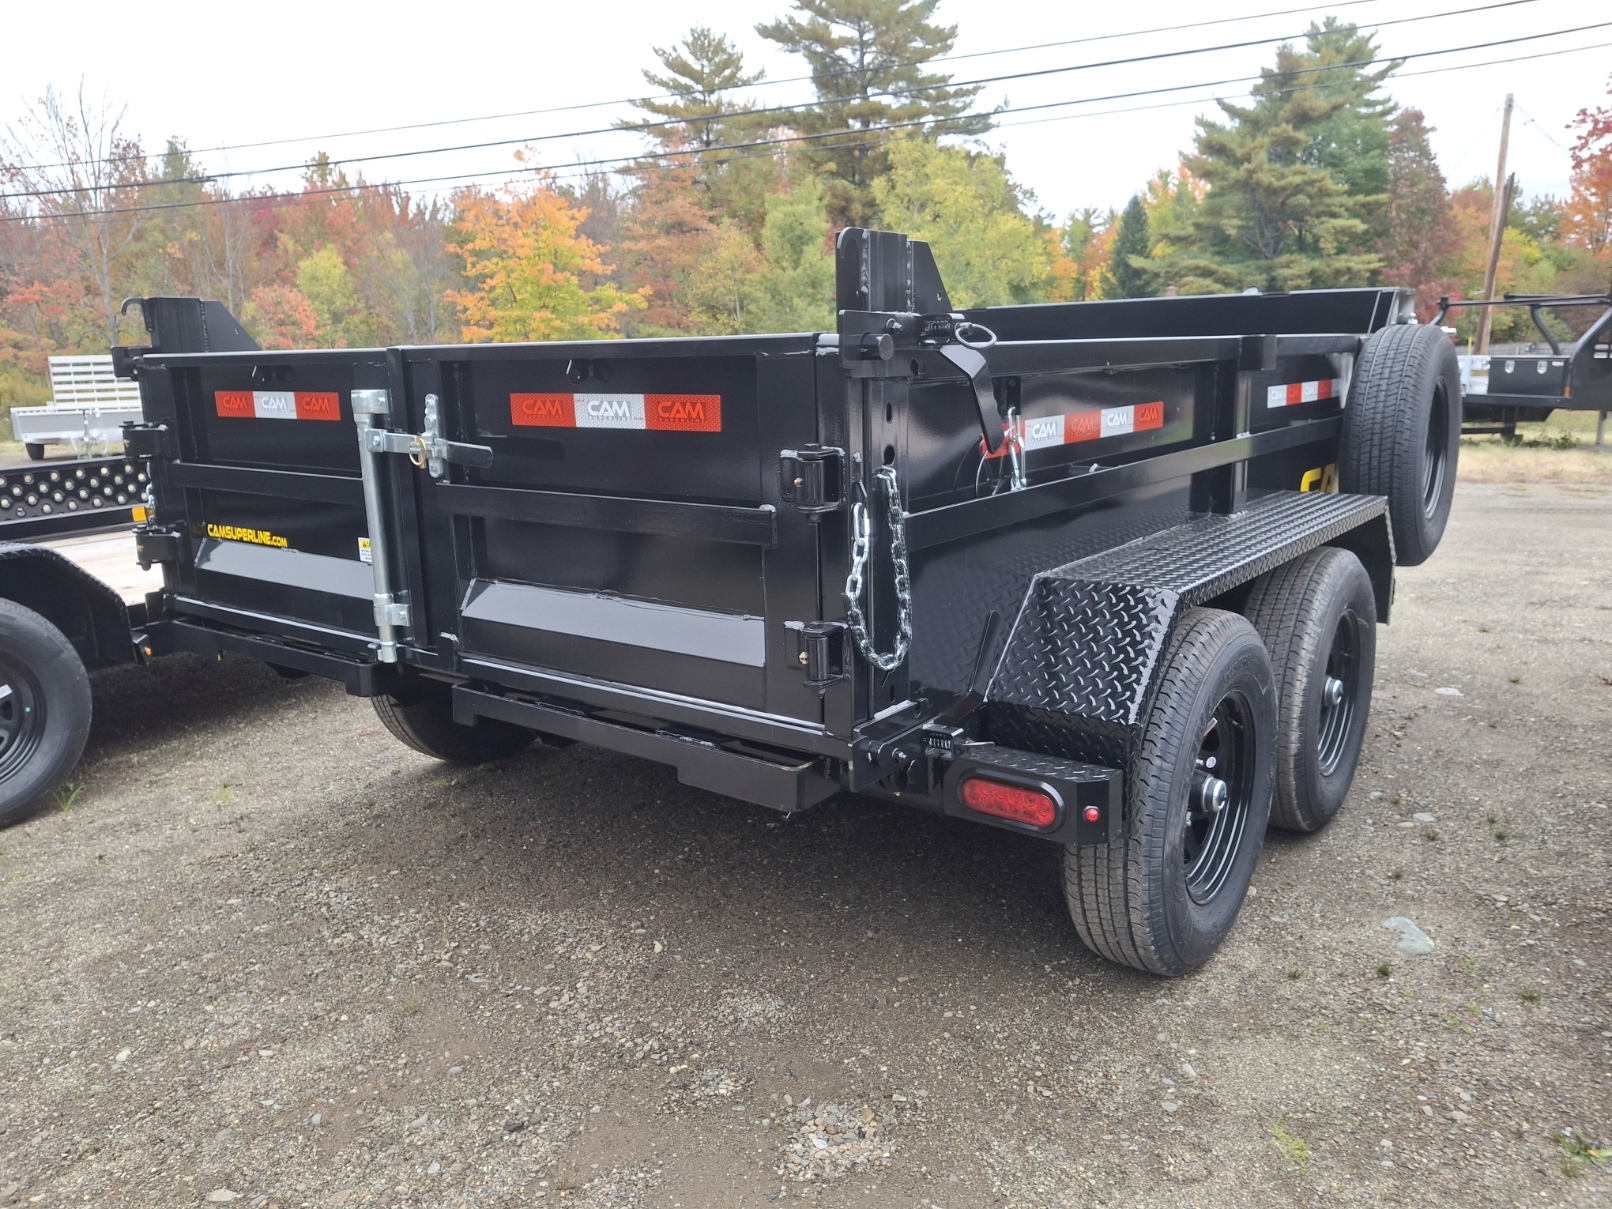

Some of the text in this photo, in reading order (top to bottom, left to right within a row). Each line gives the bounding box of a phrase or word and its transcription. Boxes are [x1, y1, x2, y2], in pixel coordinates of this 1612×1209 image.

[223, 396, 248, 409] CAM
[261, 396, 288, 410] CAM
[302, 397, 331, 411] CAM
[522, 400, 704, 419] CAM CAM CAM
[1032, 422, 1057, 439] CAM
[1072, 417, 1094, 432] CAM
[1107, 412, 1127, 427] CAM
[1138, 407, 1158, 422] CAM
[1300, 462, 1339, 493] CA
